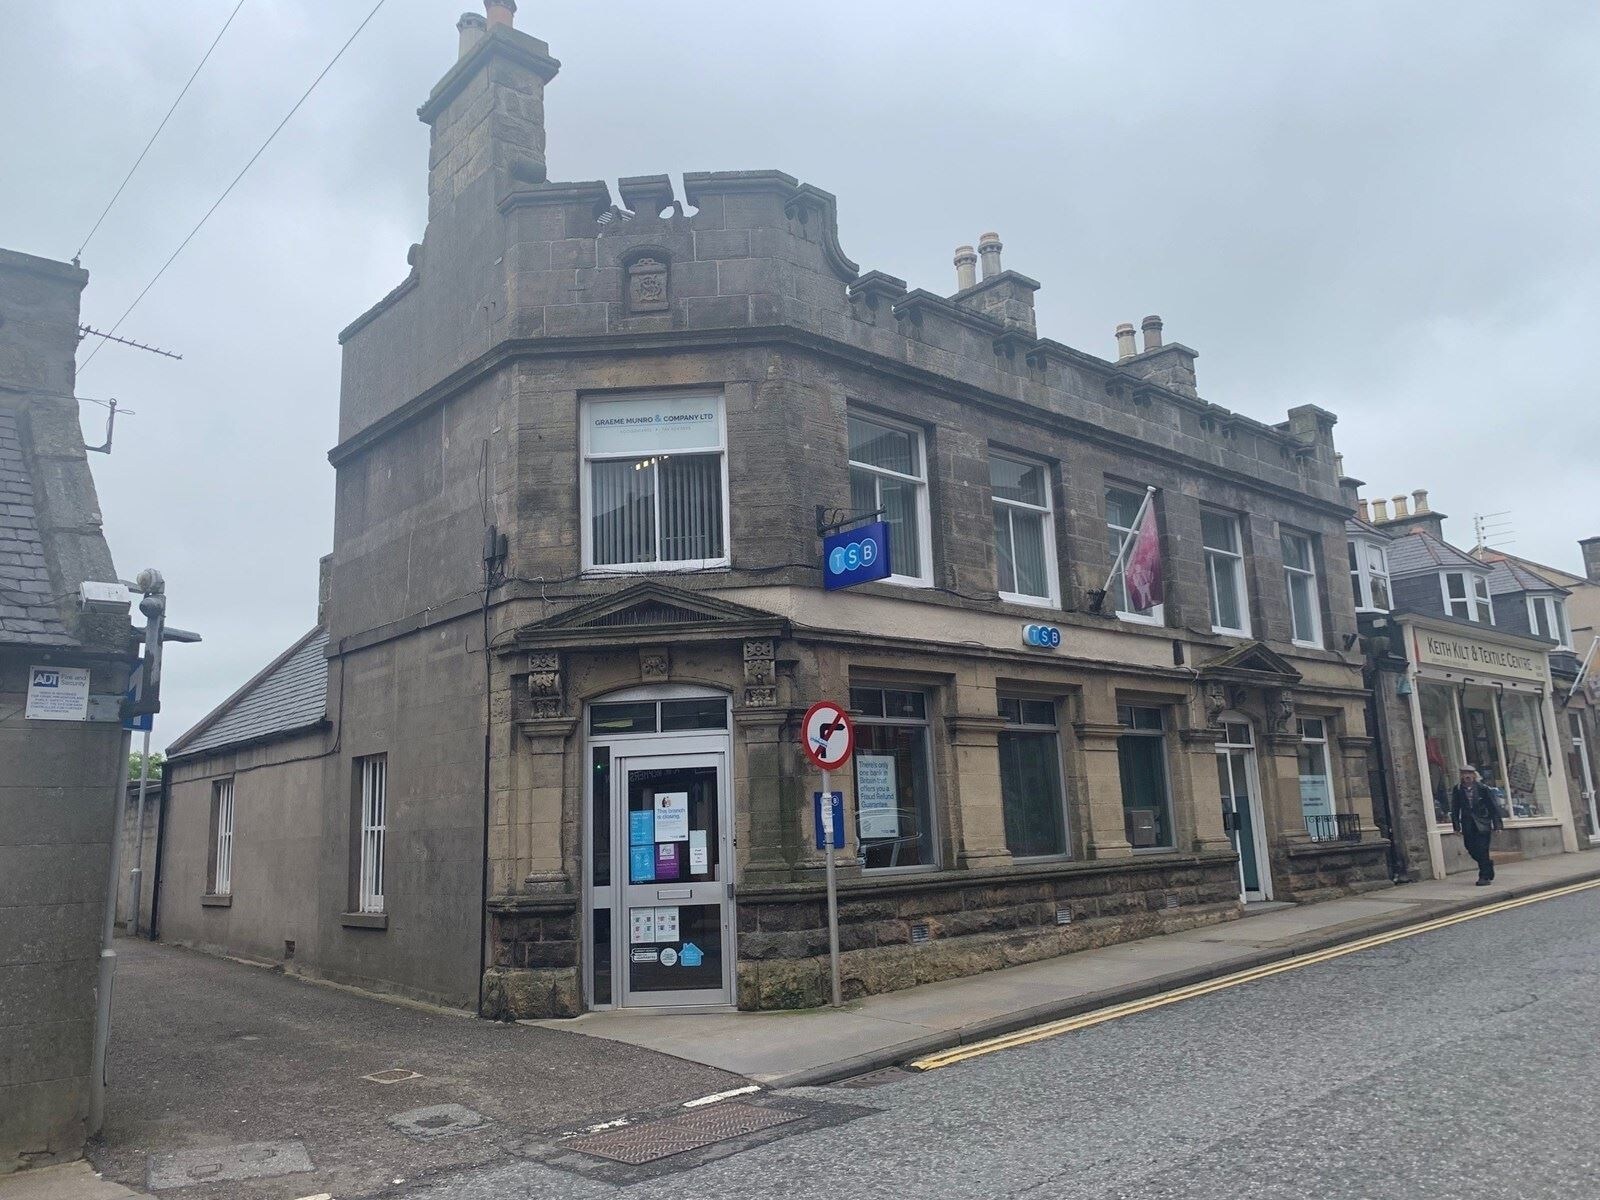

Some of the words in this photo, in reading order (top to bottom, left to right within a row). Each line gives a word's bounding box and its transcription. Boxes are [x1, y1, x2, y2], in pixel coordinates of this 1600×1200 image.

[835, 545, 872, 567] TSB
[1031, 629, 1058, 644] TSB
[1427, 637, 1452, 657] KEITH
[1452, 642, 1469, 660] KILT
[1471, 645, 1479, 661] &
[1478, 647, 1507, 667] TEXTILE
[1507, 653, 1533, 671] CENTRE
[34, 673, 59, 685] ADT
